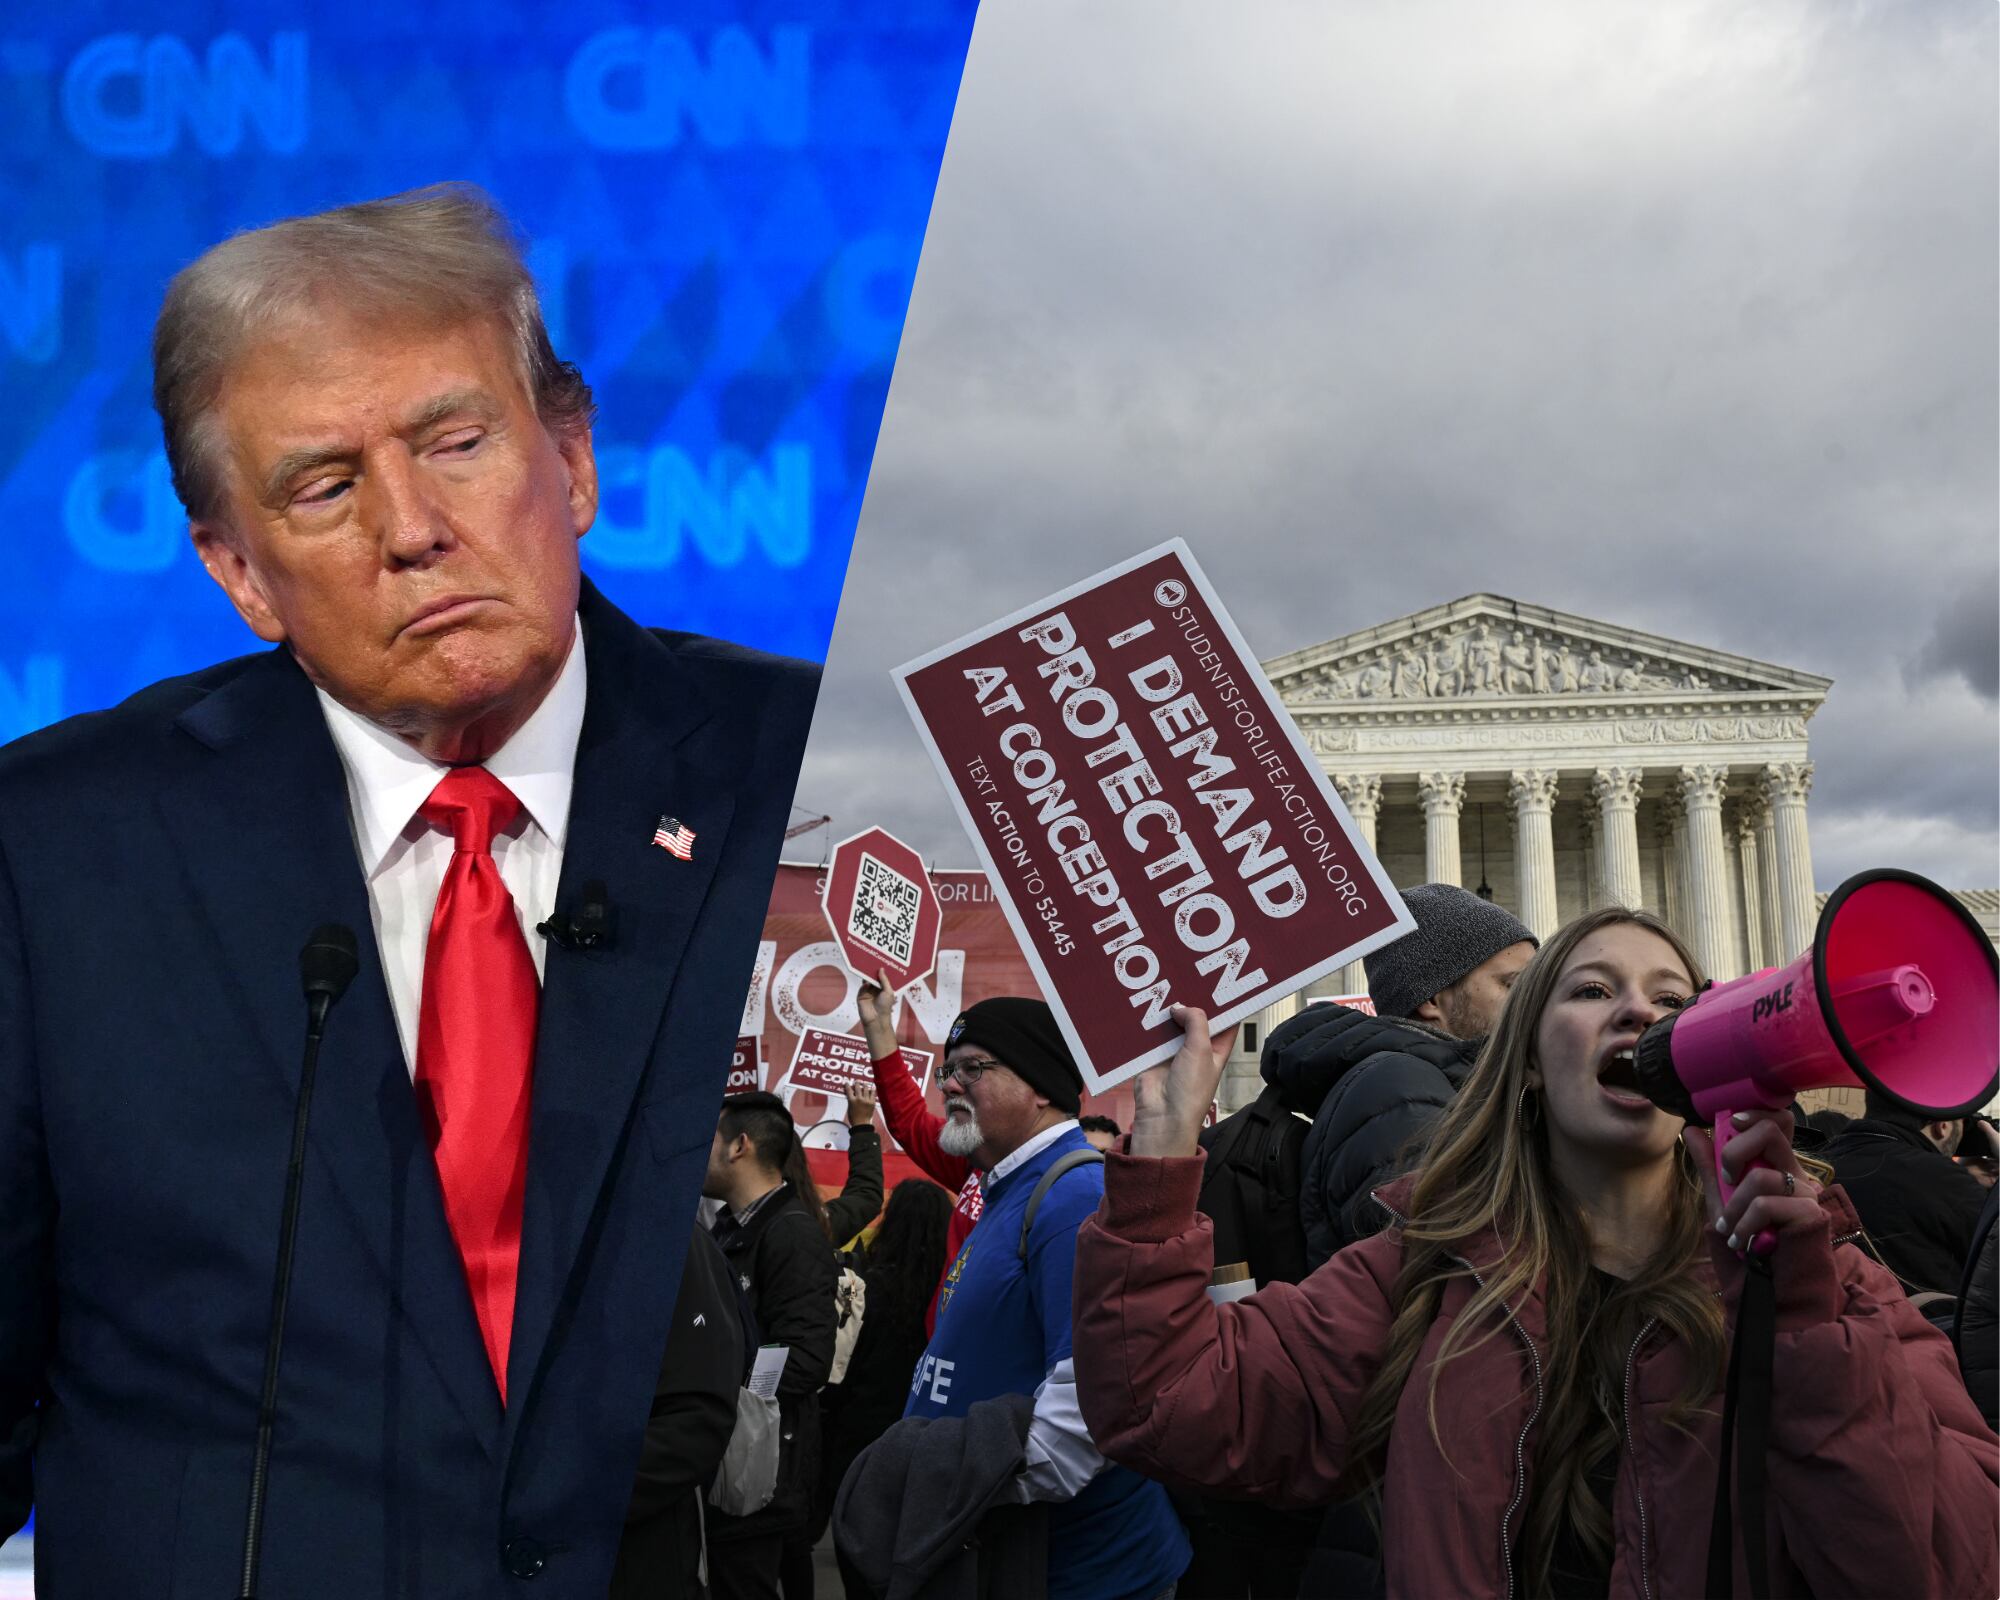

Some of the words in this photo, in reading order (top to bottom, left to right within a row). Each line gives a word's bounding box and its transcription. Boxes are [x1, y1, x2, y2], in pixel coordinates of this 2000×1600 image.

[60, 30, 311, 158] CNN
[564, 22, 812, 152] CNN
[1107, 619, 1156, 649] I
[1127, 654, 1307, 919] DEMAND
[1172, 606, 1367, 917] STUDENTSFORLIFEACTION.ORG
[1434, 730, 1500, 746] JUSTICE
[1507, 728, 1565, 743] UNDER
[1571, 727, 1606, 741] LAW
[962, 666, 1026, 717] AT
[999, 722, 1179, 1032] CONCEPTION
[965, 754, 998, 797] TEXT
[985, 800, 1033, 869] ACTION
[1022, 867, 1045, 895] TO
[1035, 896, 1076, 957] 53445
[1018, 611, 1268, 1007] PROTECTION
[817, 1041, 825, 1053] I
[1752, 980, 1793, 1024] PYLE
[798, 1068, 821, 1079] AT
